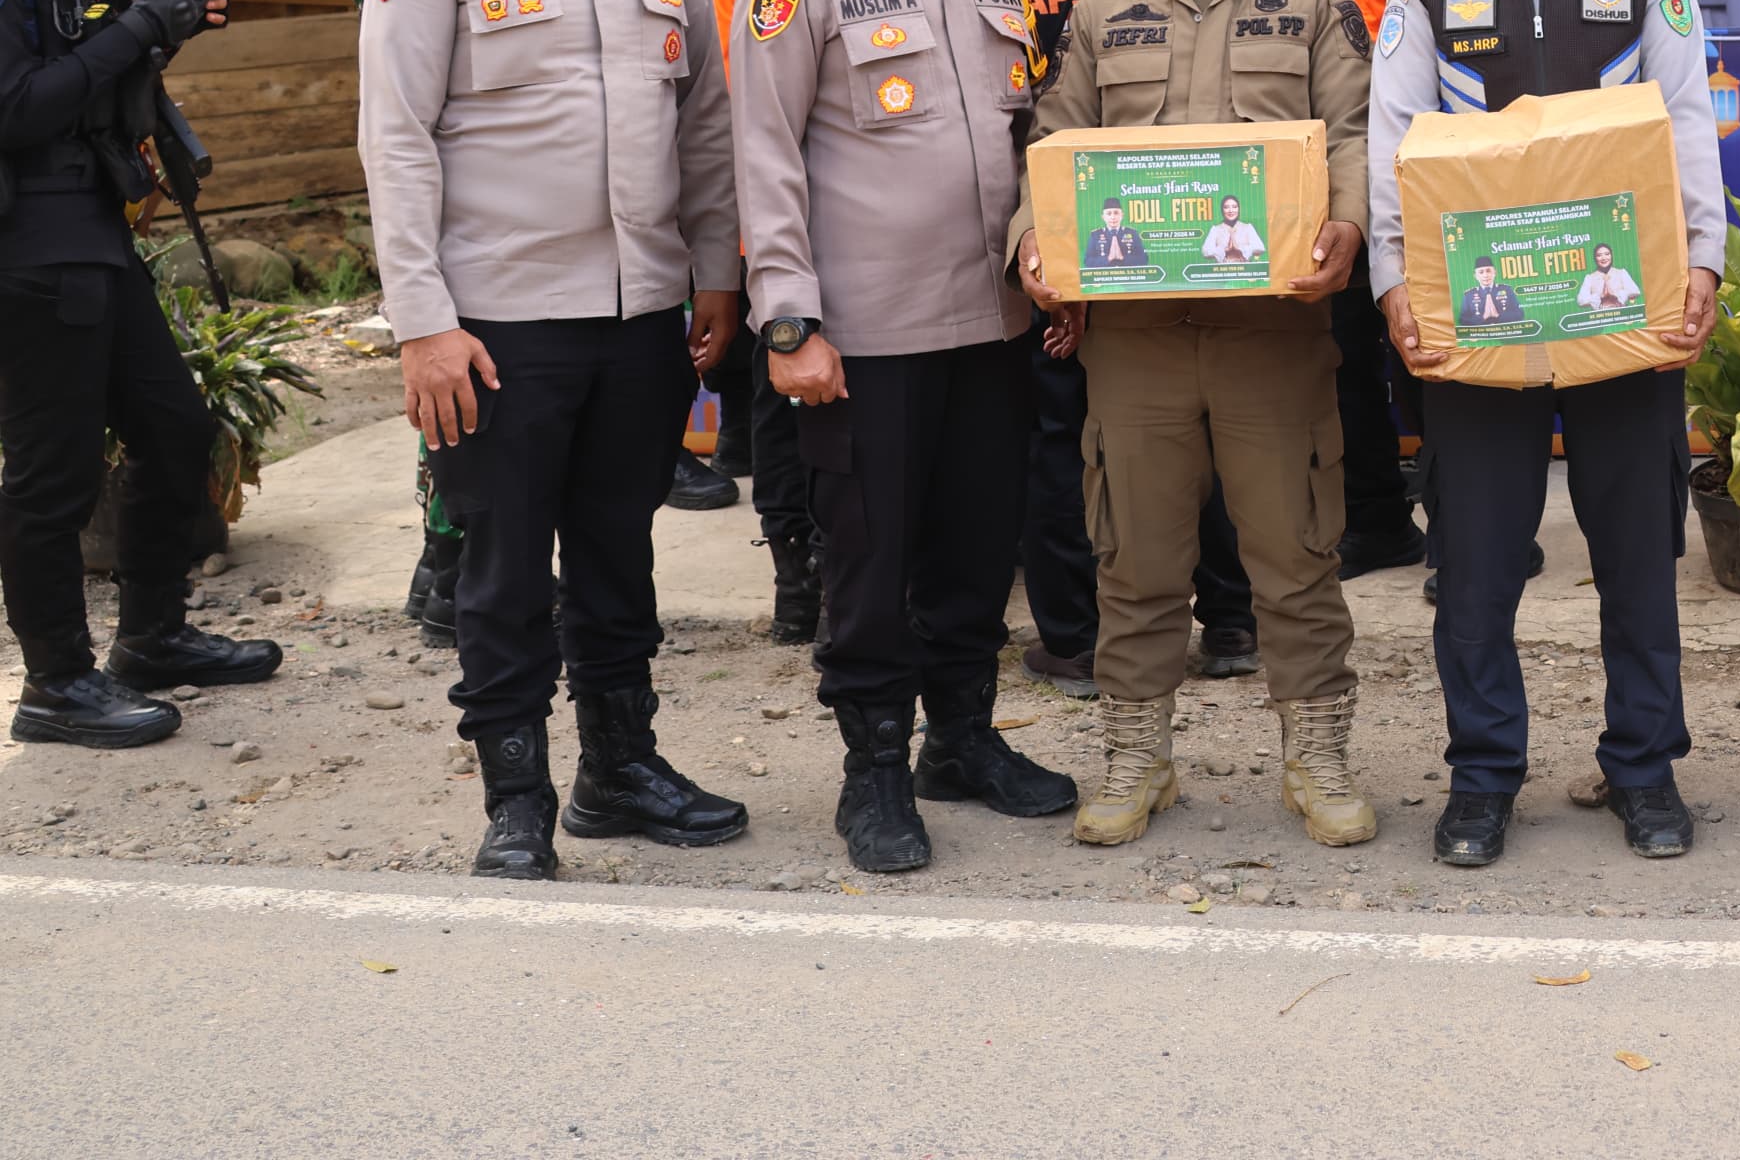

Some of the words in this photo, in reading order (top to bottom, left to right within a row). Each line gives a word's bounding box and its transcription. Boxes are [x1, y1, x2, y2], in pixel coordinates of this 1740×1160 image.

[1585, 9, 1629, 20] DISHUB
[1235, 17, 1273, 38] POL
[1278, 15, 1305, 37] PP
[1102, 25, 1169, 49] JEFRI
[1452, 37, 1499, 54] MS.HRP
[1117, 155, 1154, 163] KAPOLRES
[1117, 162, 1146, 170] BESERTA
[1120, 183, 1161, 196] Selamat
[1163, 180, 1189, 195] Hari
[1191, 181, 1219, 194] Raya
[1128, 199, 1165, 224] IDUL
[1172, 197, 1213, 222] FITRI
[1485, 213, 1522, 222] KAPOLRES
[1523, 209, 1558, 218] TAPANULI
[1559, 204, 1589, 213] SELATAN
[1485, 220, 1515, 229] BESERTA
[1516, 218, 1534, 226] STAF
[1491, 240, 1533, 254] Selamat
[1534, 235, 1560, 250] Hari
[1562, 233, 1590, 245] Raya
[1500, 254, 1539, 280] IDUL
[1544, 247, 1586, 275] FITRI
